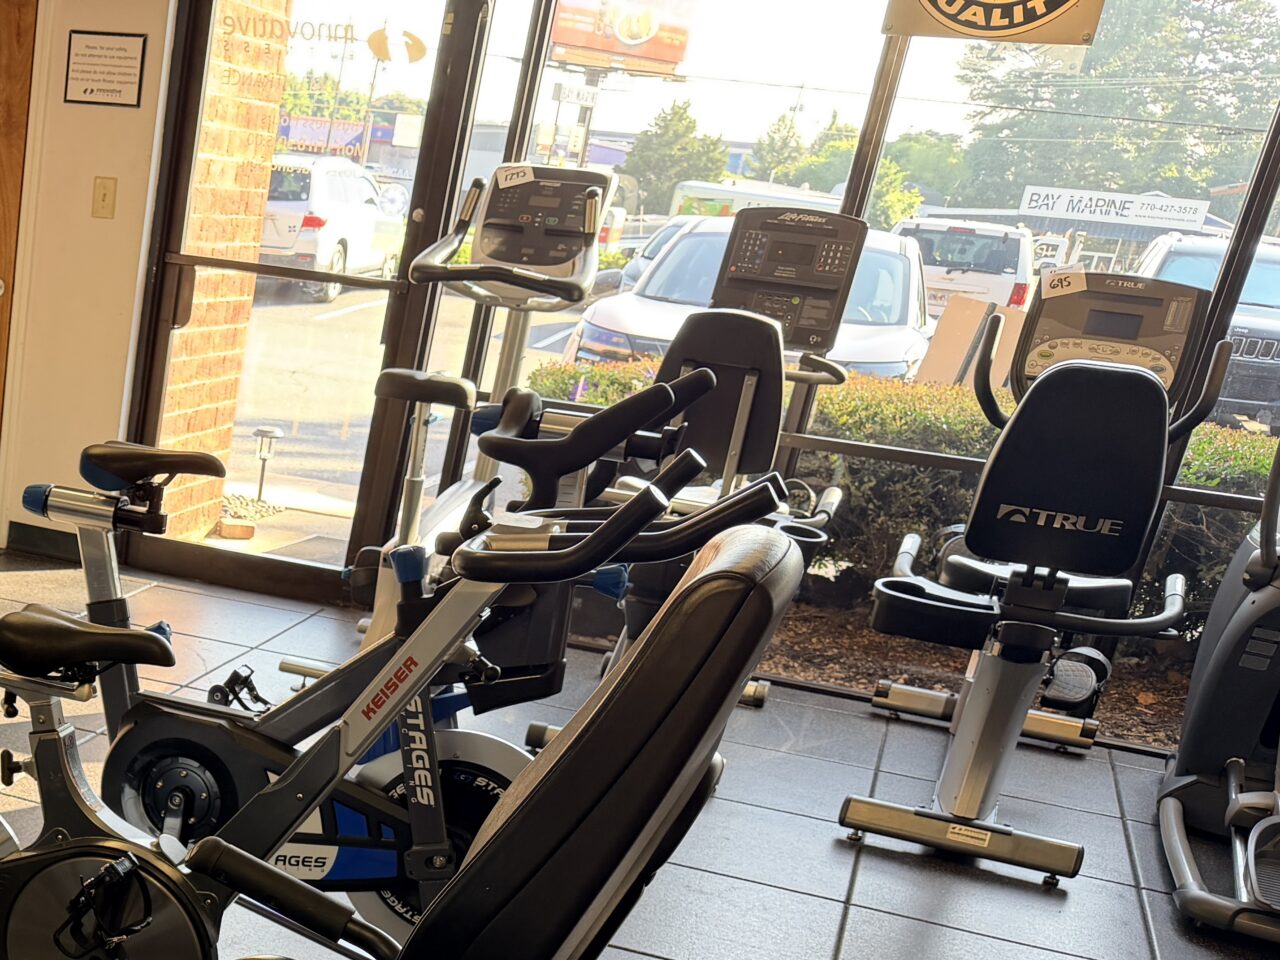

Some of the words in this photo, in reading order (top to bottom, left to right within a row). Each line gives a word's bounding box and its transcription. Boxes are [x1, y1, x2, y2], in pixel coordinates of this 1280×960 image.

[1027, 192, 1061, 211] BAY
[1065, 195, 1134, 218] MARINE
[1139, 202, 1199, 215] 770-427-3578
[1048, 276, 1072, 290] 695
[1117, 280, 1146, 290] TRUE
[1031, 508, 1124, 536] TRUE
[361, 655, 419, 721] KEISER
